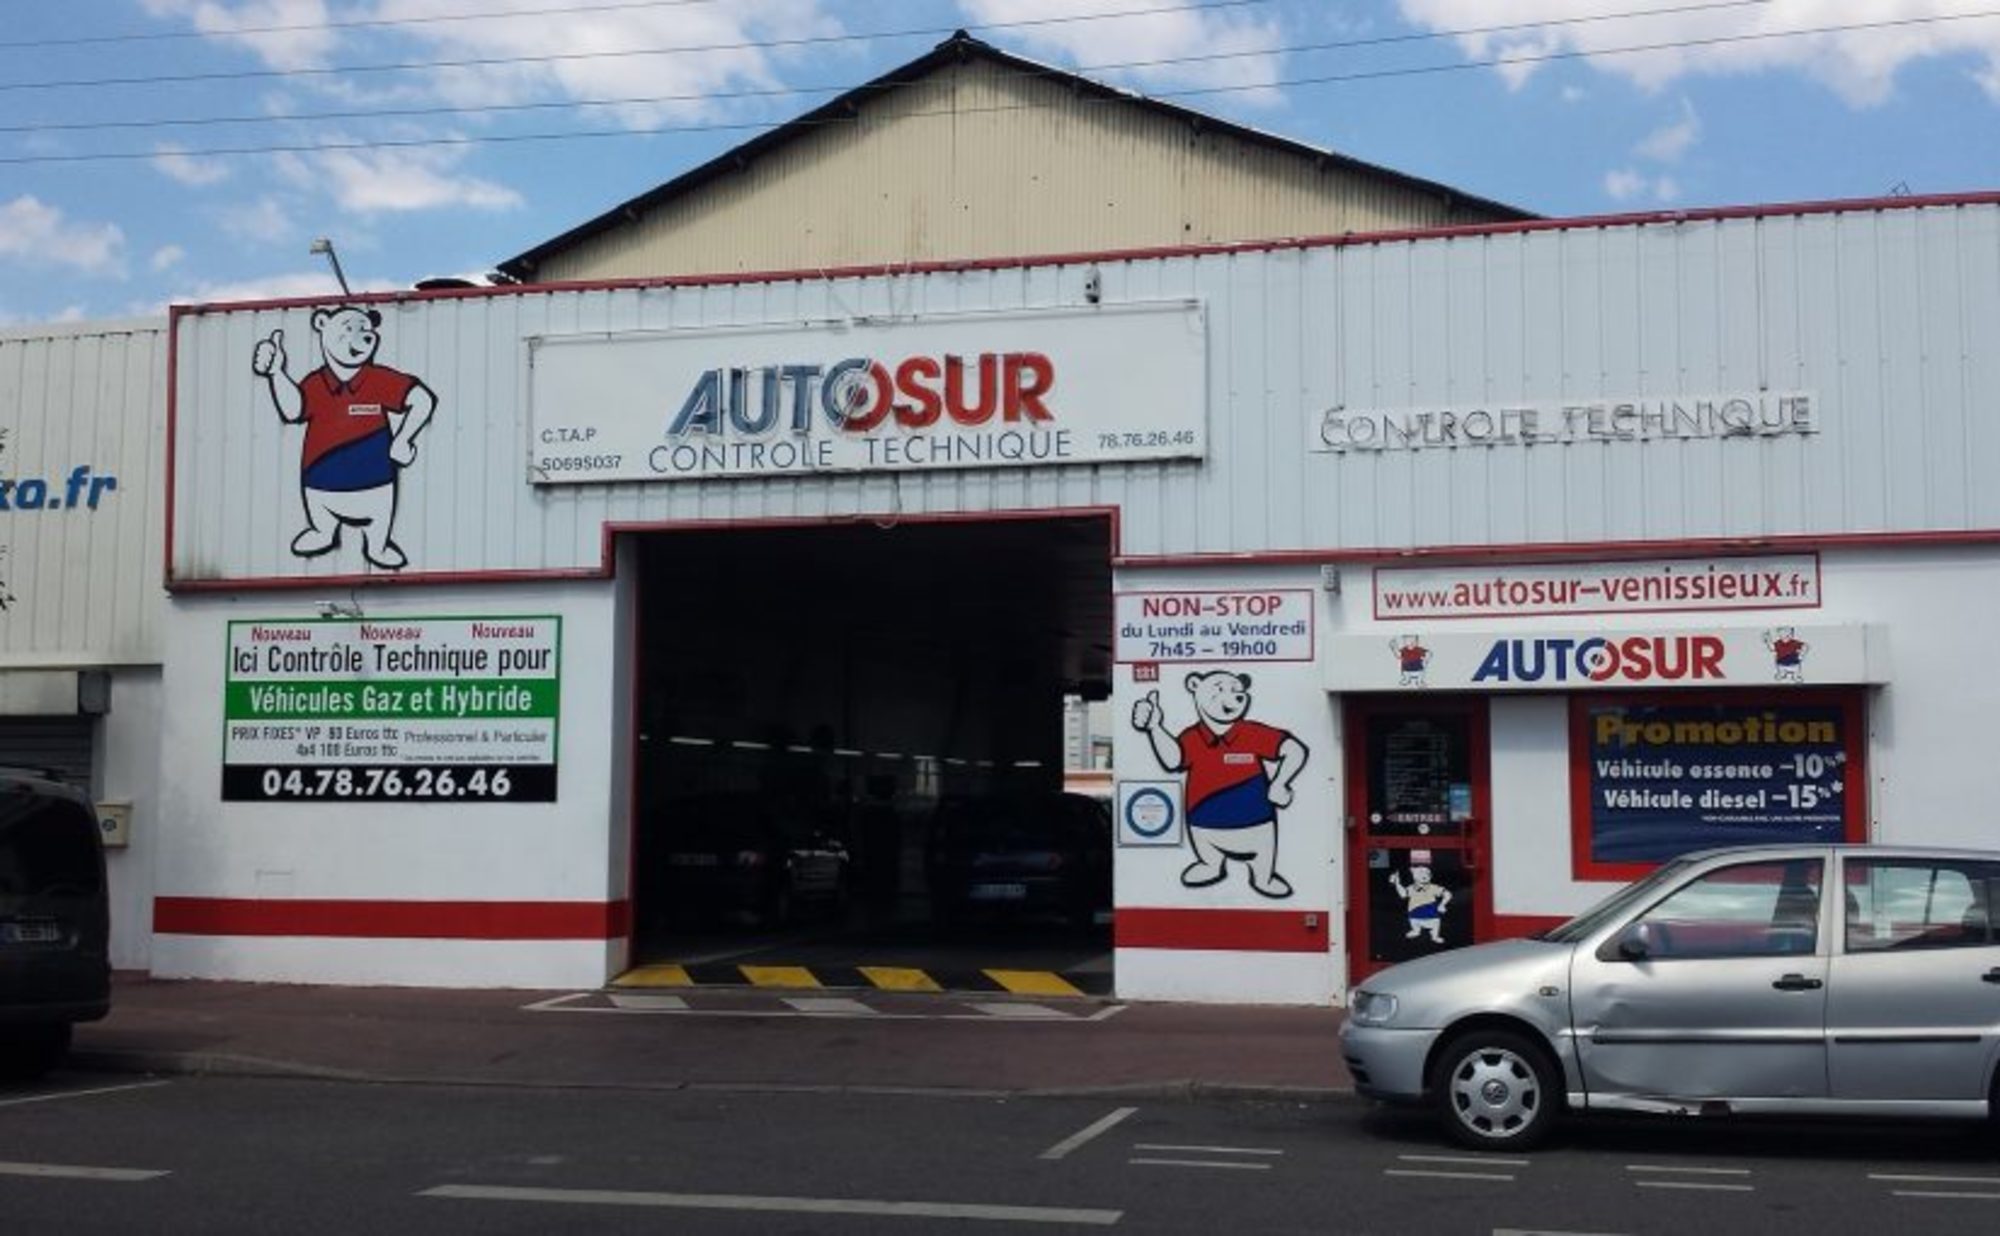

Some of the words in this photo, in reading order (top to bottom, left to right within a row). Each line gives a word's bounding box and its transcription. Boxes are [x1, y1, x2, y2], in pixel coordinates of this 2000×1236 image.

[665, 351, 1056, 437] AUTOSUR
[1561, 397, 1811, 438] TECHNIQUE
[540, 427, 598, 444] C.T.A.P
[1097, 430, 1195, 450] 78.76.26.46
[648, 440, 833, 475] CONTROLE
[863, 429, 1072, 467] TECHNIQUE
[1384, 566, 1811, 608] www.autosur-venissieux.fr
[1142, 594, 1283, 618] NON-STOP
[251, 627, 311, 640] Nouveau
[359, 624, 421, 639] Nouveau
[471, 622, 535, 638] Nouveau
[1121, 622, 1143, 639] du
[1148, 621, 1194, 638] Lundi
[1199, 624, 1221, 637] au
[1227, 619, 1306, 637] Vendredi
[233, 646, 258, 672] Ici
[267, 642, 364, 673] Contrôle
[372, 643, 489, 677] Technique
[497, 646, 552, 676] pour
[1148, 641, 1196, 658] 7h45
[1221, 639, 1277, 656] 19h00
[1471, 636, 1726, 681] AUTOSUR
[250, 685, 356, 713] Véhicules
[362, 685, 403, 711] Gaz
[410, 686, 437, 711] et
[441, 684, 534, 716] Hybride
[232, 726, 260, 740] PRIX
[304, 726, 321, 740] VP
[345, 725, 379, 740] Euros
[1597, 714, 1834, 745] Promotion
[344, 743, 378, 757] Euros
[1597, 758, 1683, 779] Véhicule
[1689, 763, 1773, 779] essence
[262, 769, 512, 796] 04.78.76.26.46
[1604, 788, 1693, 808] Véhicule
[1699, 789, 1766, 808] diesel
